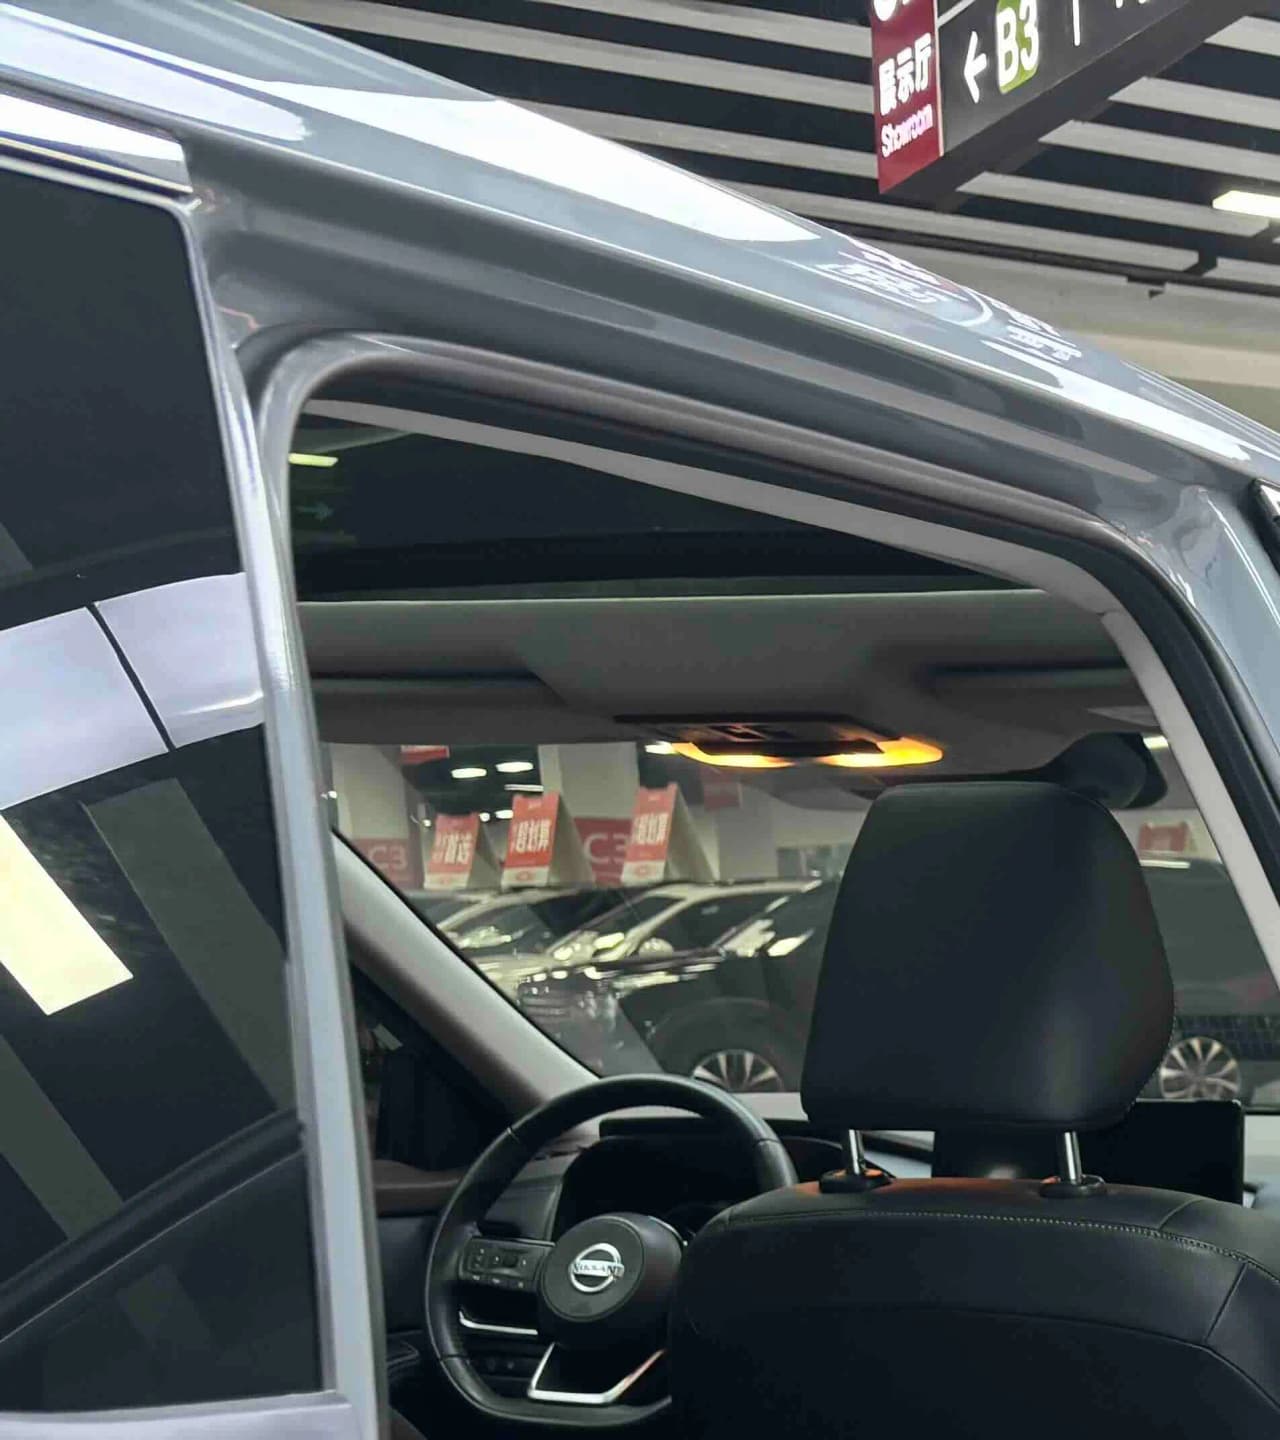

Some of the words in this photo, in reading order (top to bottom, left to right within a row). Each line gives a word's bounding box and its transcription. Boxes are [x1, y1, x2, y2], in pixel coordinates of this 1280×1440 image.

[878, 32, 932, 116] 展示厅
[996, 0, 1039, 87] B3
[880, 104, 933, 158] Showroom
